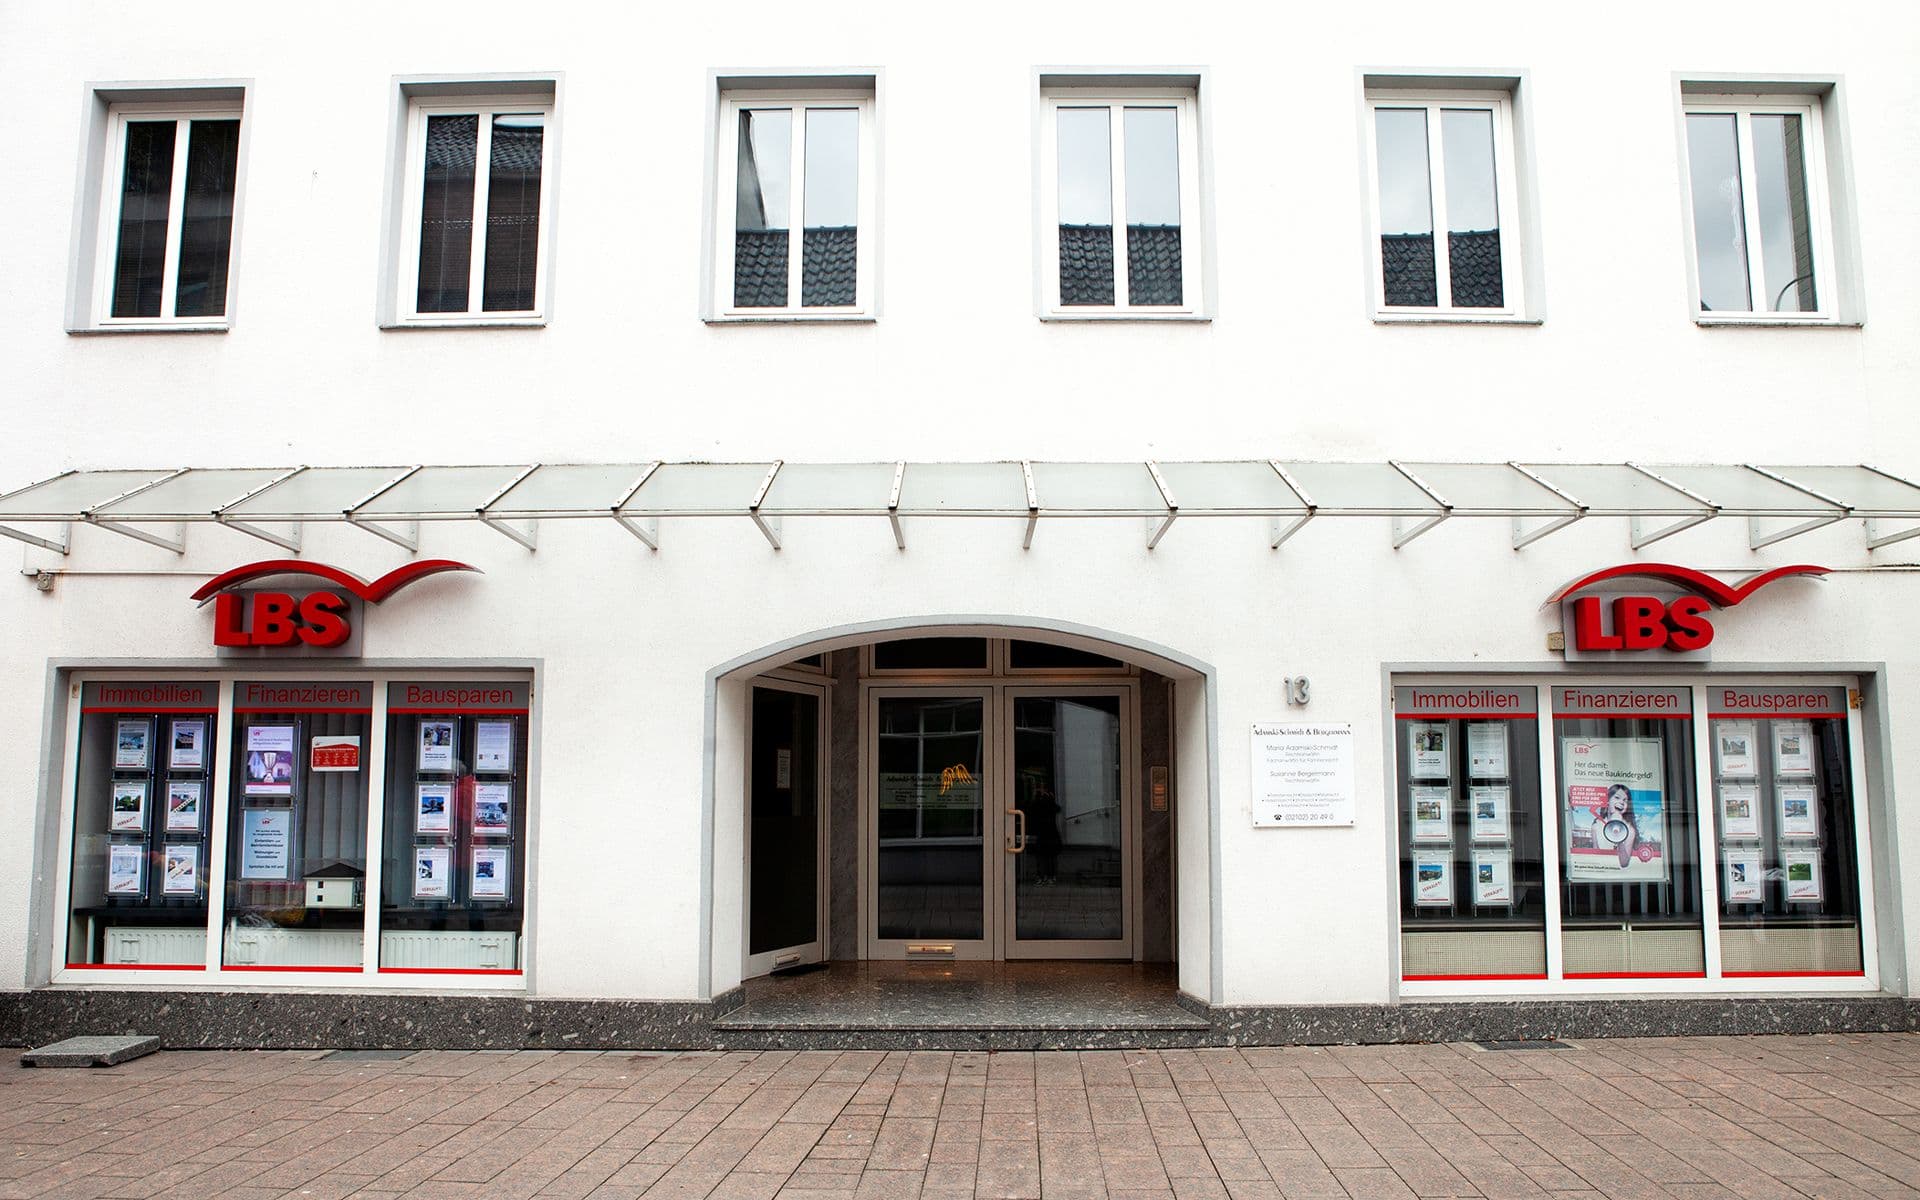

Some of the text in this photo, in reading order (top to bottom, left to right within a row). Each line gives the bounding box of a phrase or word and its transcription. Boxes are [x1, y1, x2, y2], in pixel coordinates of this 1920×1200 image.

[214, 592, 351, 648] LBS
[1574, 596, 1714, 652] LBS
[101, 685, 203, 703] Immobilien
[247, 685, 361, 703] Finanzieren
[407, 686, 513, 707] Bausparen
[1284, 675, 1310, 705] 13
[1413, 691, 1519, 708] Immobilien
[1564, 691, 1677, 708] Finanzieren
[1724, 691, 1828, 711] Bausparen
[1306, 728, 1312, 736] &
[1605, 770, 1653, 780] Baukindergeld!
